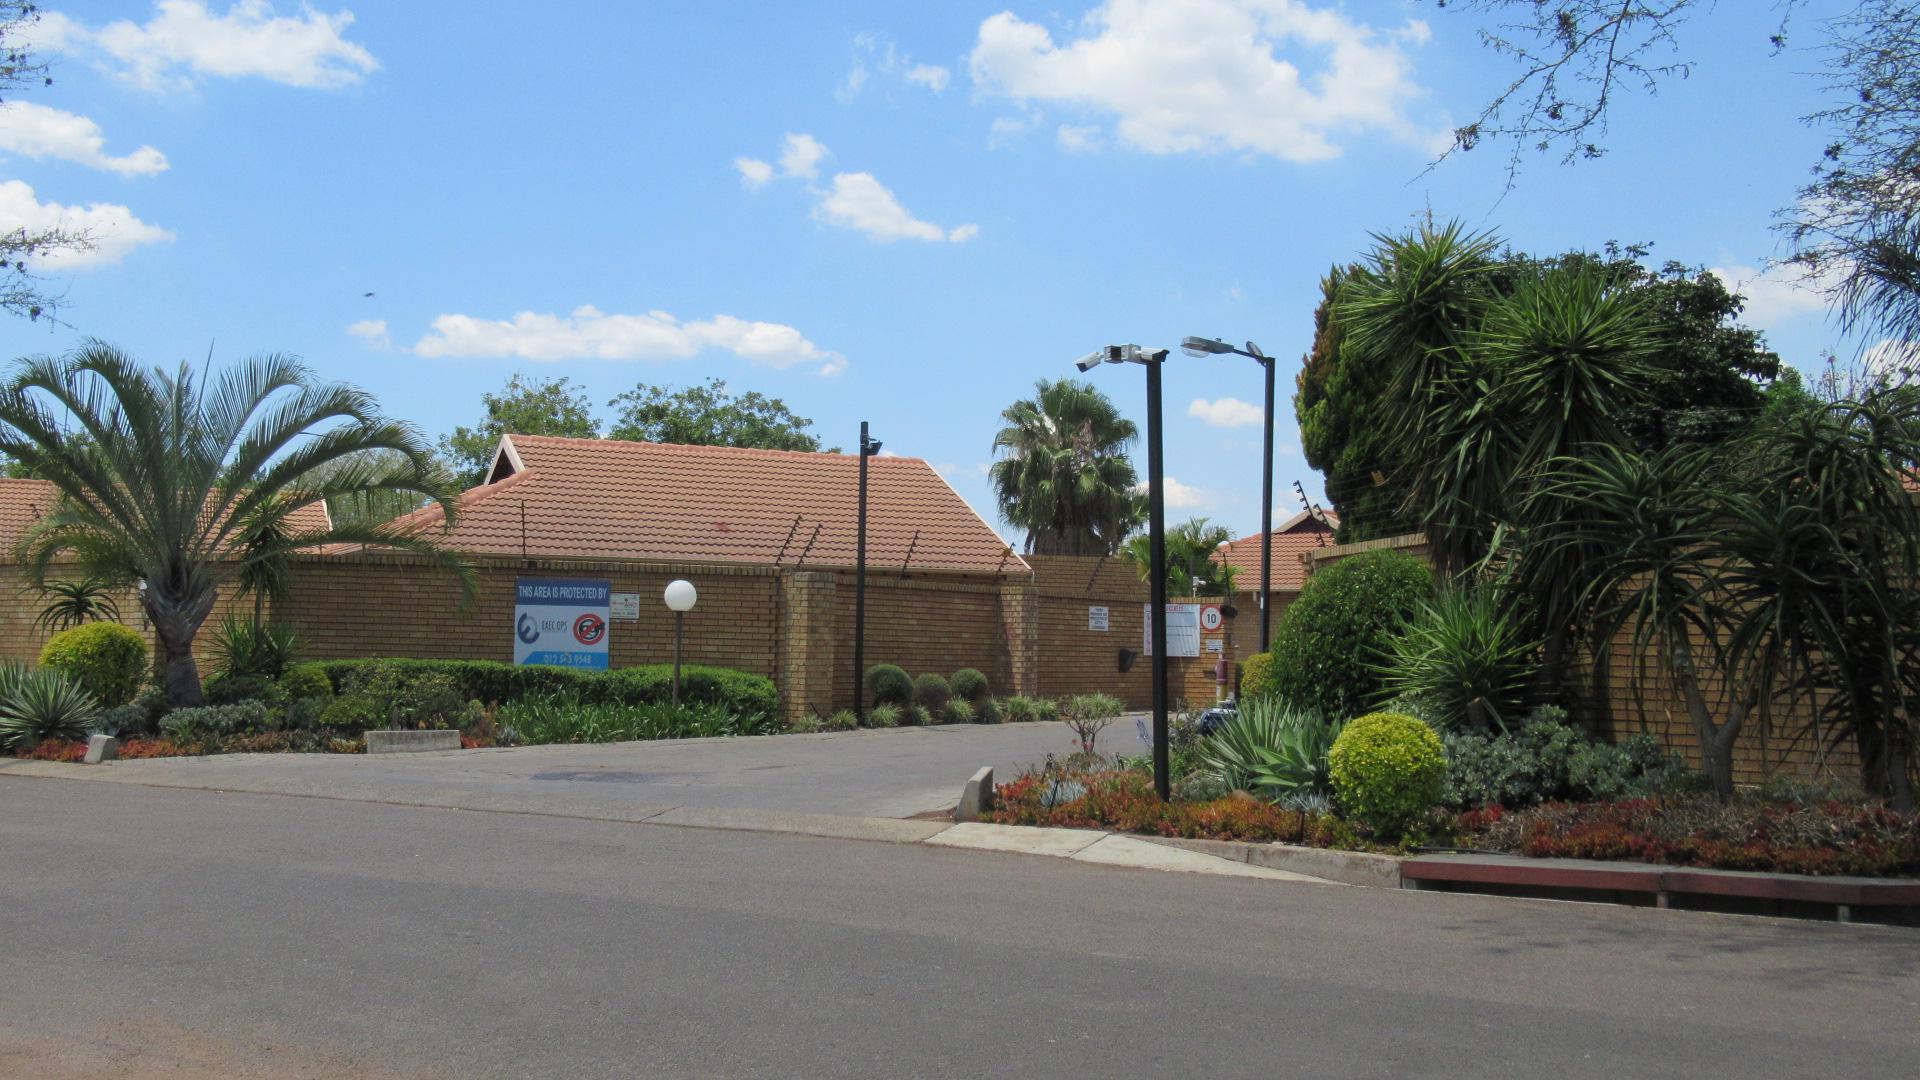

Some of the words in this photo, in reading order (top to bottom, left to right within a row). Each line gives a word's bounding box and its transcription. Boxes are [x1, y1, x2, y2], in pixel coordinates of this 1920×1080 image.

[519, 586, 532, 597] THIS
[534, 586, 551, 598] AREA
[552, 587, 558, 598] IS
[560, 587, 597, 599] PROTECTED
[598, 588, 607, 599] BY
[1207, 614, 1217, 623] 10
[556, 620, 568, 631] OPS
[544, 654, 558, 664] 012
